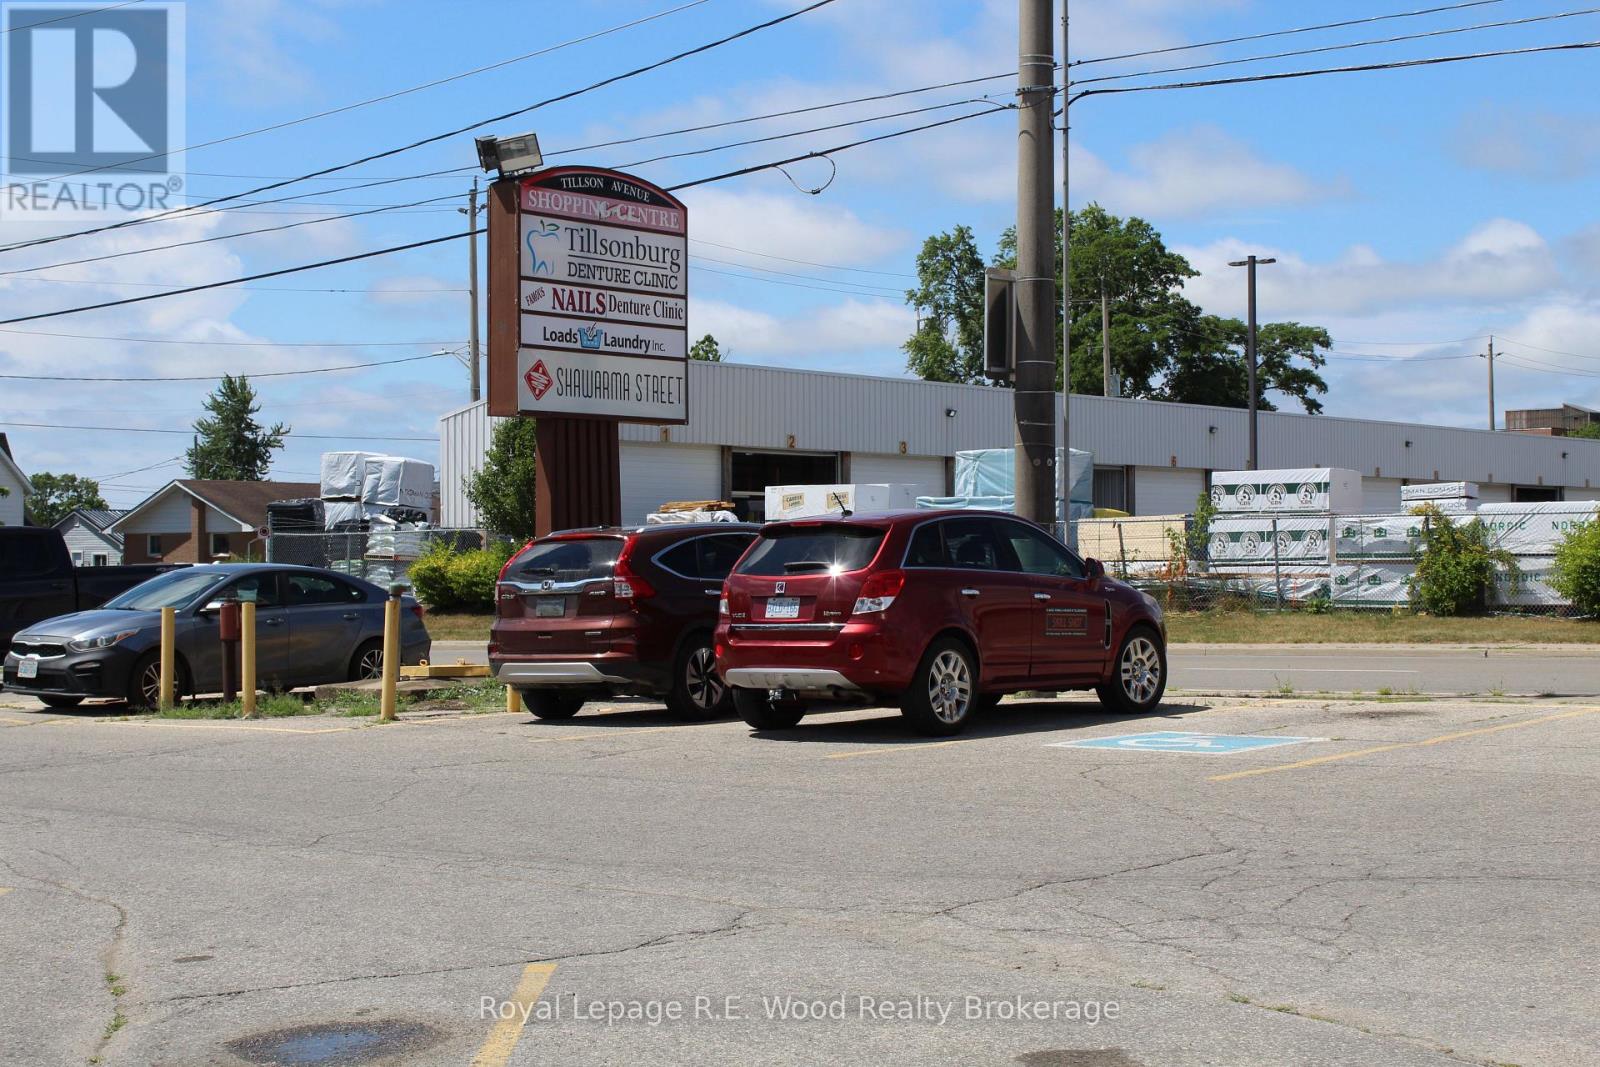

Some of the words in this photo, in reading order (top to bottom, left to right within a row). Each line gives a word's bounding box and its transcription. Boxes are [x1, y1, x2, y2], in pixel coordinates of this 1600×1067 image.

[560, 177, 604, 189] TILLSON
[611, 182, 650, 203] AVENUE
[528, 189, 611, 219] SHOPPING
[616, 203, 680, 229] CENTRE
[565, 227, 681, 274] Tillsonburg
[568, 262, 631, 284] DENTURE
[634, 271, 678, 290] CLINIC
[552, 287, 606, 315] NAILS
[609, 294, 651, 317] Denture
[653, 300, 683, 320] Clinic
[543, 326, 578, 344] Loads
[604, 332, 650, 353] Laundry
[652, 340, 666, 352] Inc.
[556, 367, 630, 402] SHAWARMA
[636, 374, 683, 404] STREET
[788, 435, 795, 448] 2
[900, 441, 907, 454] 3
